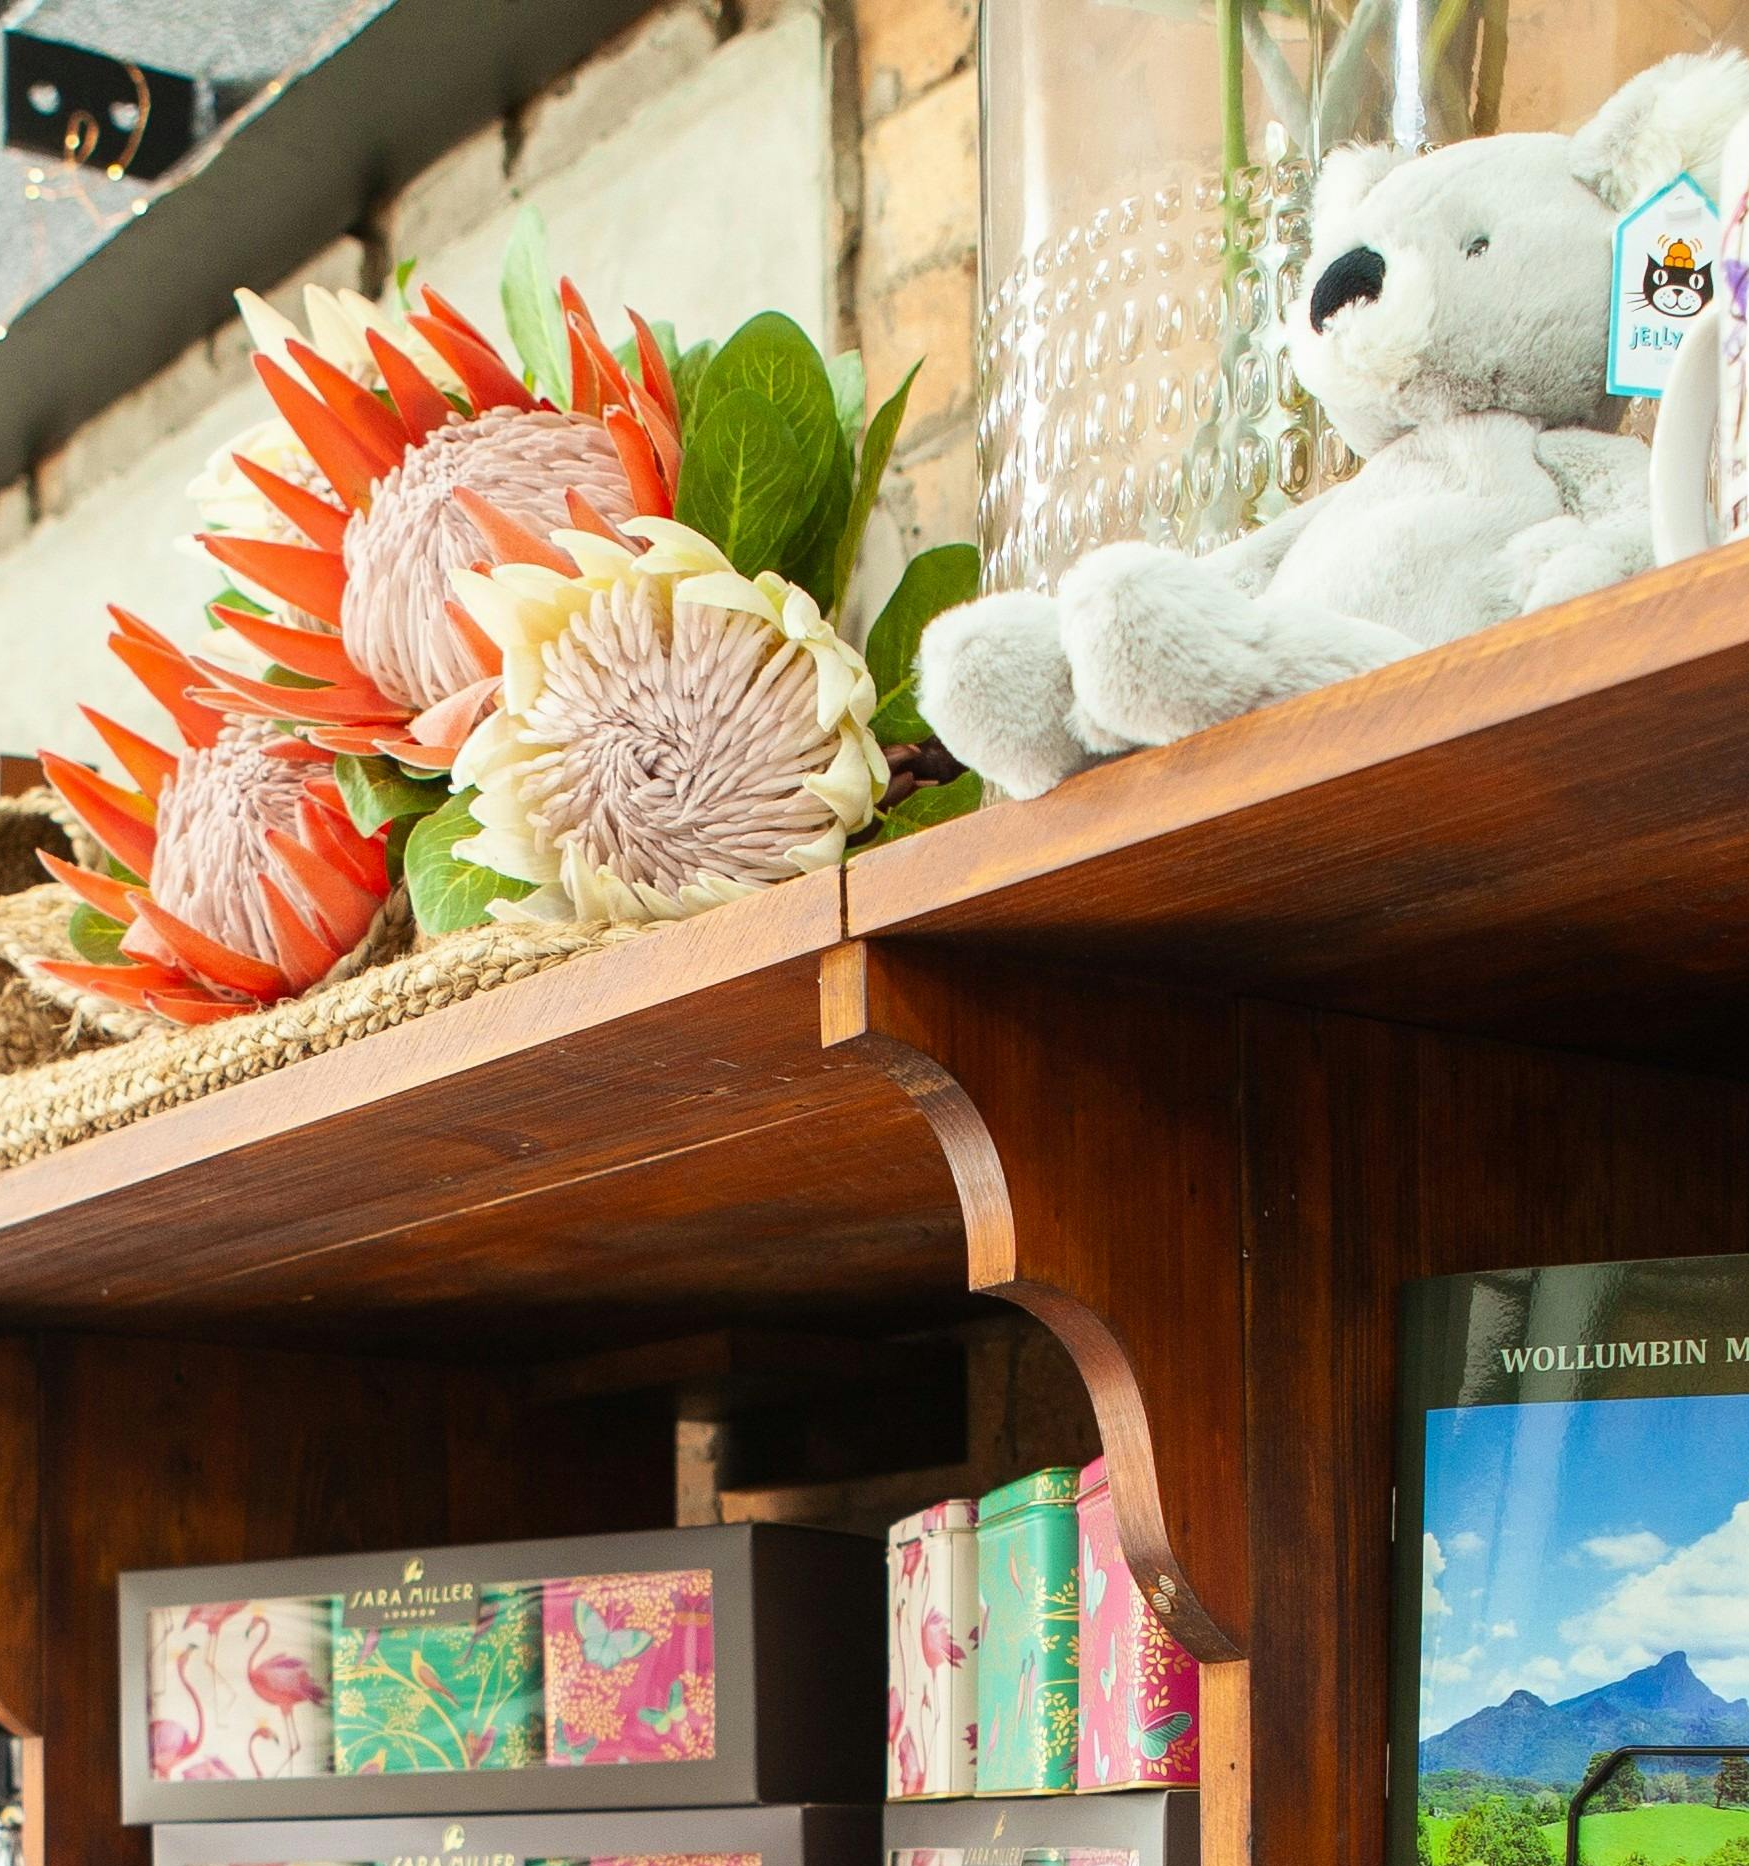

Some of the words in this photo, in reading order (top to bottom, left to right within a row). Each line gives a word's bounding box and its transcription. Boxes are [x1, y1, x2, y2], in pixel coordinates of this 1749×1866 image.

[1501, 1337, 1707, 1374] WOLLUMBIN
[350, 1587, 402, 1609] SARA
[408, 1582, 474, 1605] MILLER
